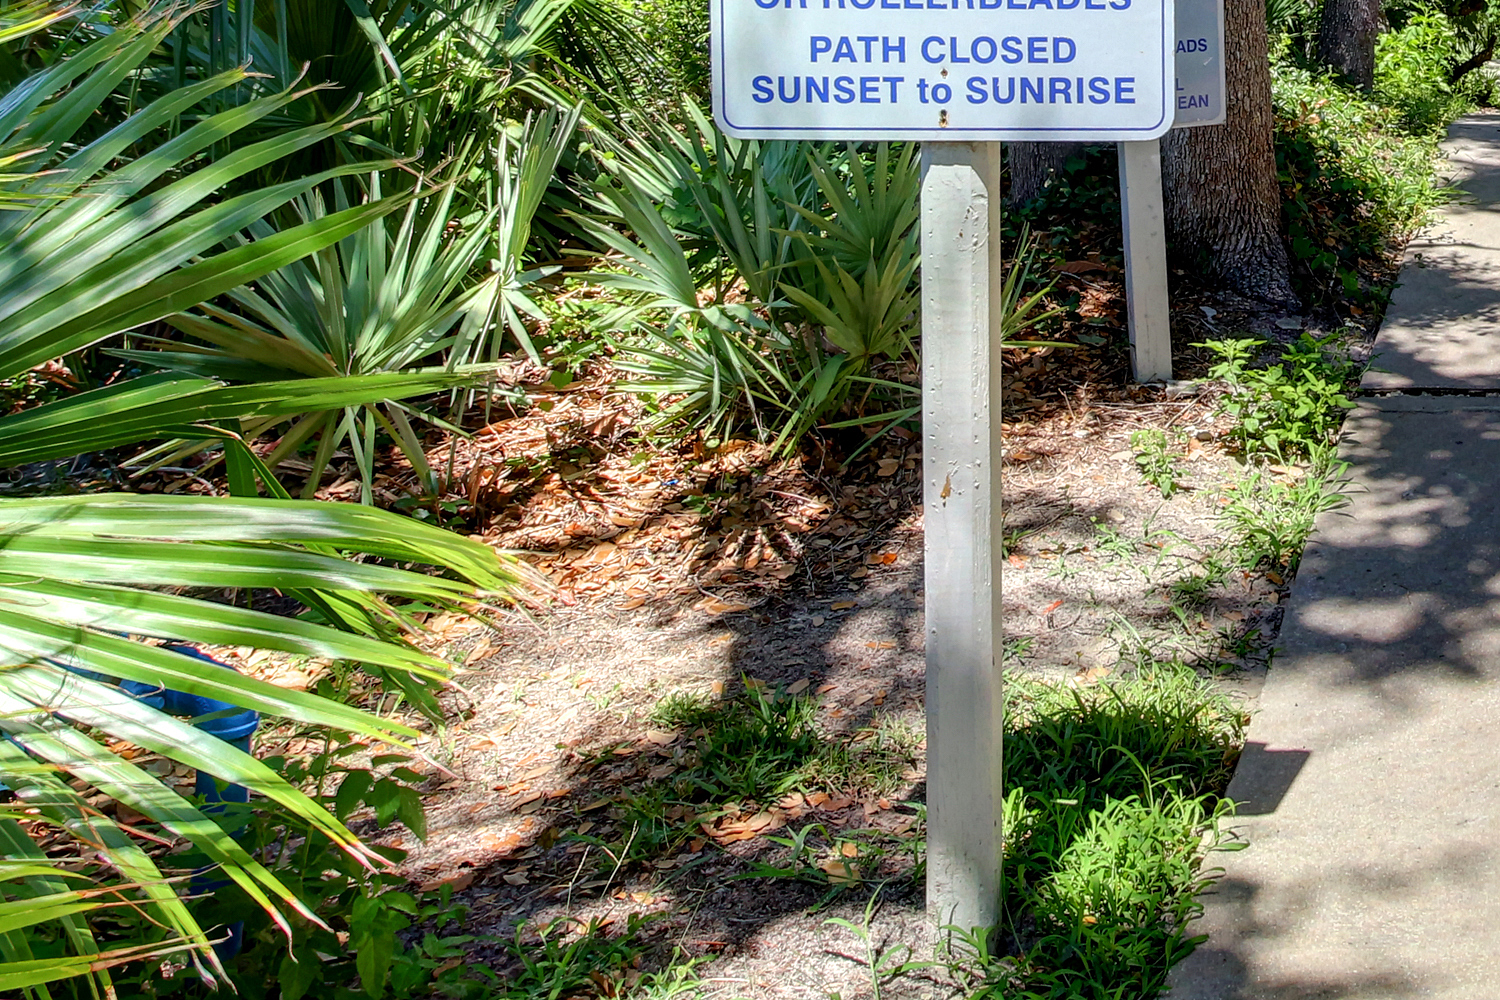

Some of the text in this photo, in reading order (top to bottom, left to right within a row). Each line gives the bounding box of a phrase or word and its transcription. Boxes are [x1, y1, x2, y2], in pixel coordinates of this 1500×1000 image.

[809, 35, 1077, 64] PATH CLOSED
[751, 75, 1136, 105] SUNSET to SUNRISE
